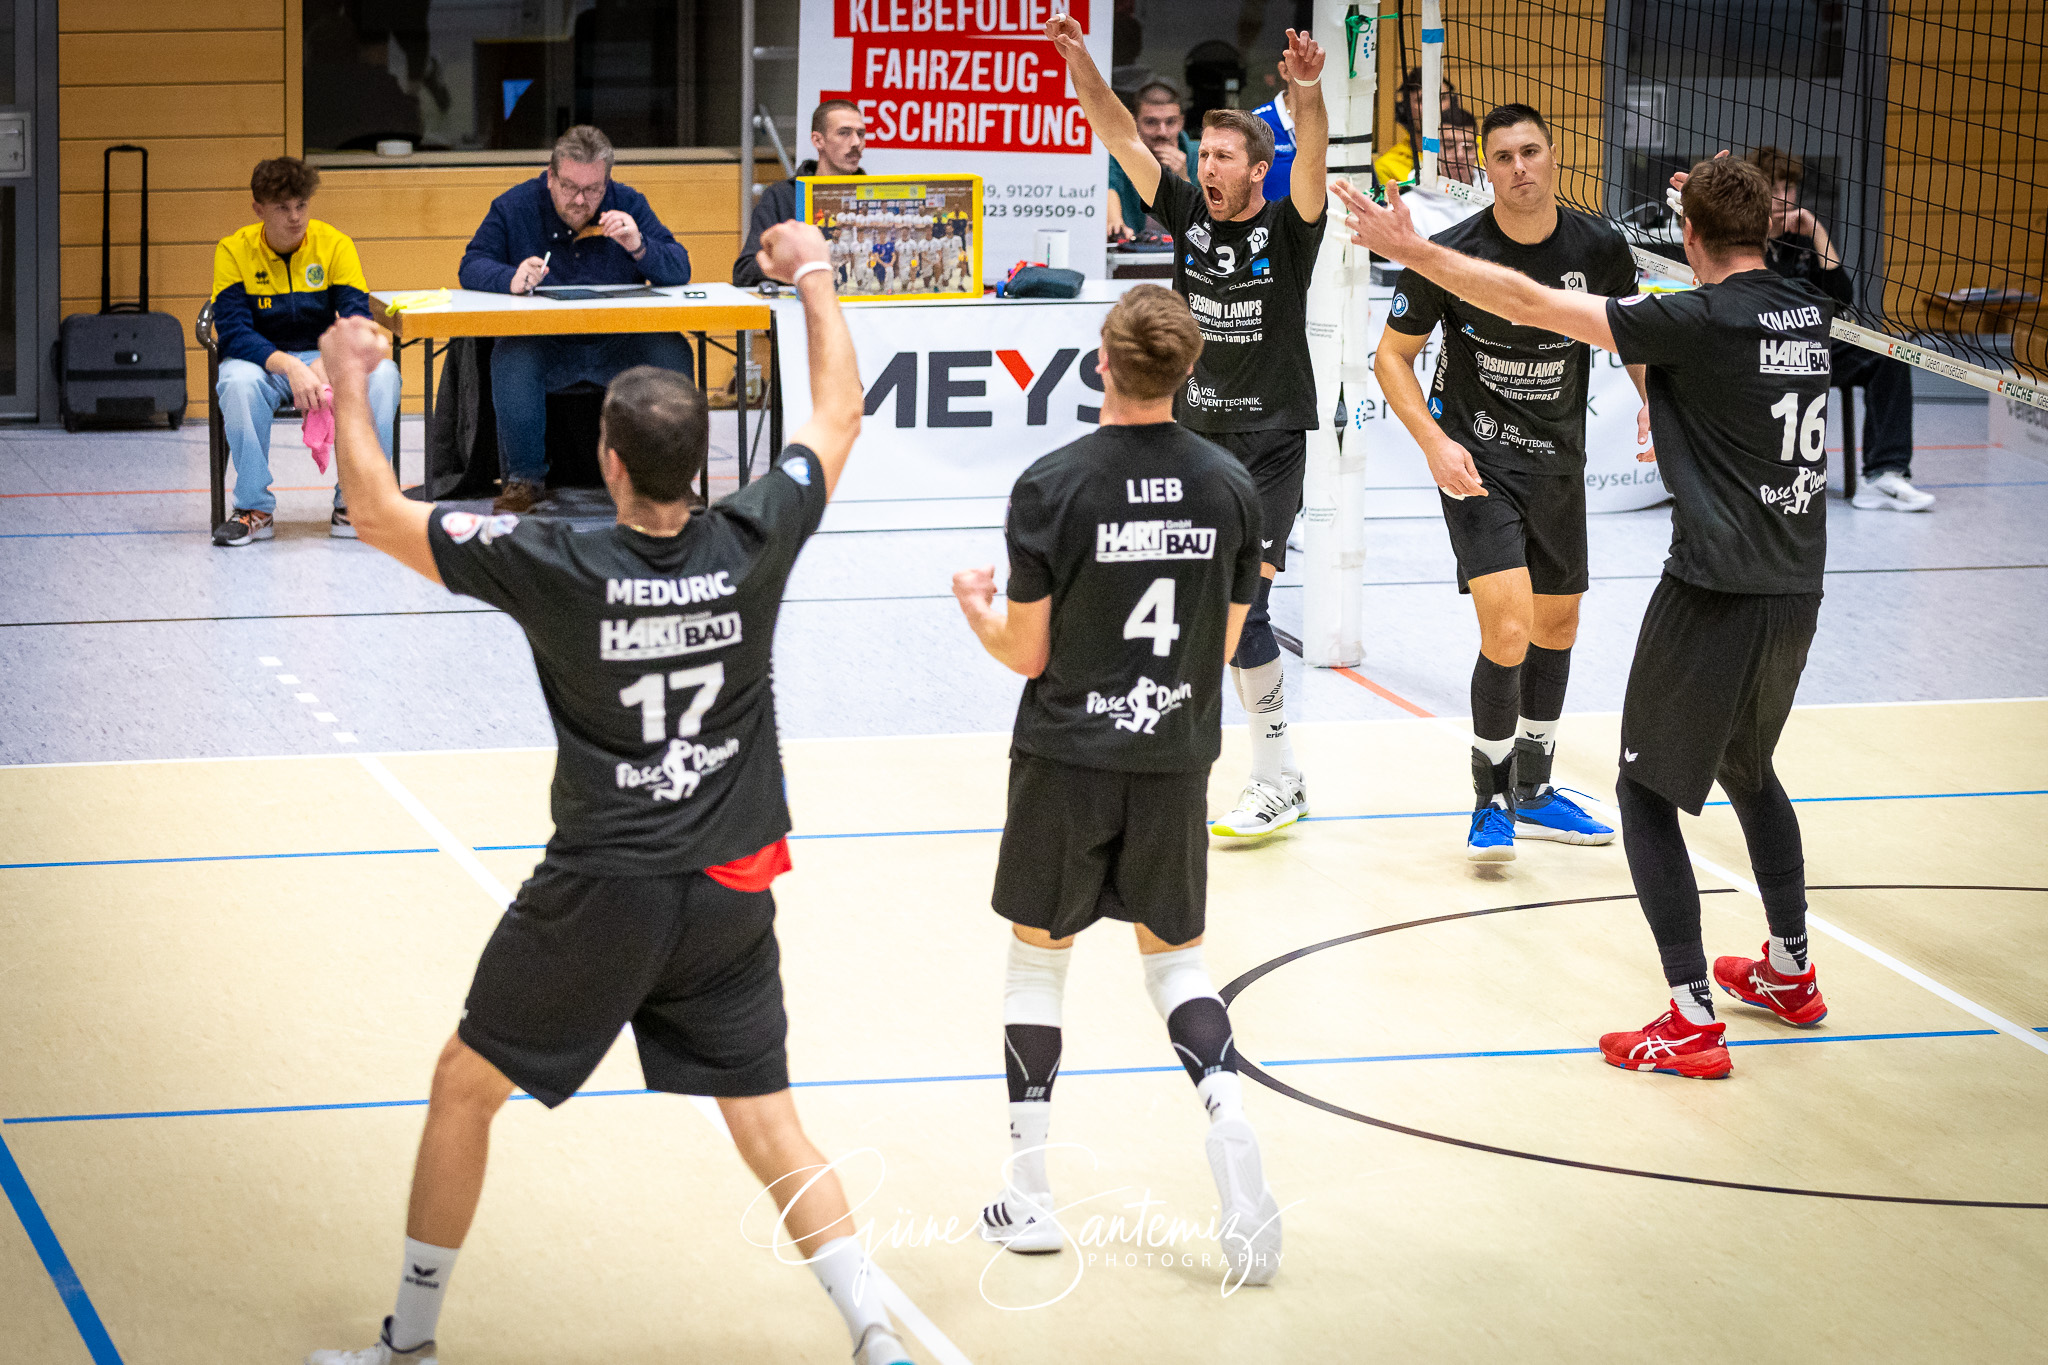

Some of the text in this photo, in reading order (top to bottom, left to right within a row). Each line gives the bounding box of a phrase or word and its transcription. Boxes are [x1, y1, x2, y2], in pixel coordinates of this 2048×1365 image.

[865, 47, 1059, 93] FAHRZEUG-
[859, 99, 1087, 147] ESCHRIFTUNG
[1006, 184, 1053, 198] 91207
[1059, 184, 1097, 198] Lauf
[1013, 204, 1095, 218] 999509-0
[1208, 246, 1236, 275] 3
[257, 296, 272, 310] LR
[1224, 299, 1262, 319] LAMPS
[1235, 317, 1262, 327] Products
[1757, 305, 1823, 331] KNAUER
[1760, 339, 1809, 367] HART
[1894, 345, 1922, 365] FUCHS
[1527, 359, 1566, 378] LAMPS
[1200, 386, 1217, 398] VSL
[1509, 376, 1536, 386] Lighted
[2004, 383, 2034, 402] FUCHS
[1503, 423, 1521, 436] VSL
[1770, 392, 1827, 462] 16
[1126, 478, 1183, 504] LIEB
[1760, 484, 1792, 505] Pose
[1097, 520, 1165, 552] HART
[1166, 533, 1212, 555] BAU
[606, 570, 737, 606] MEDURIC
[1123, 577, 1180, 657] 4
[600, 614, 736, 650] HART BAU
[619, 661, 725, 744] 17
[1086, 690, 1128, 714] Pose
